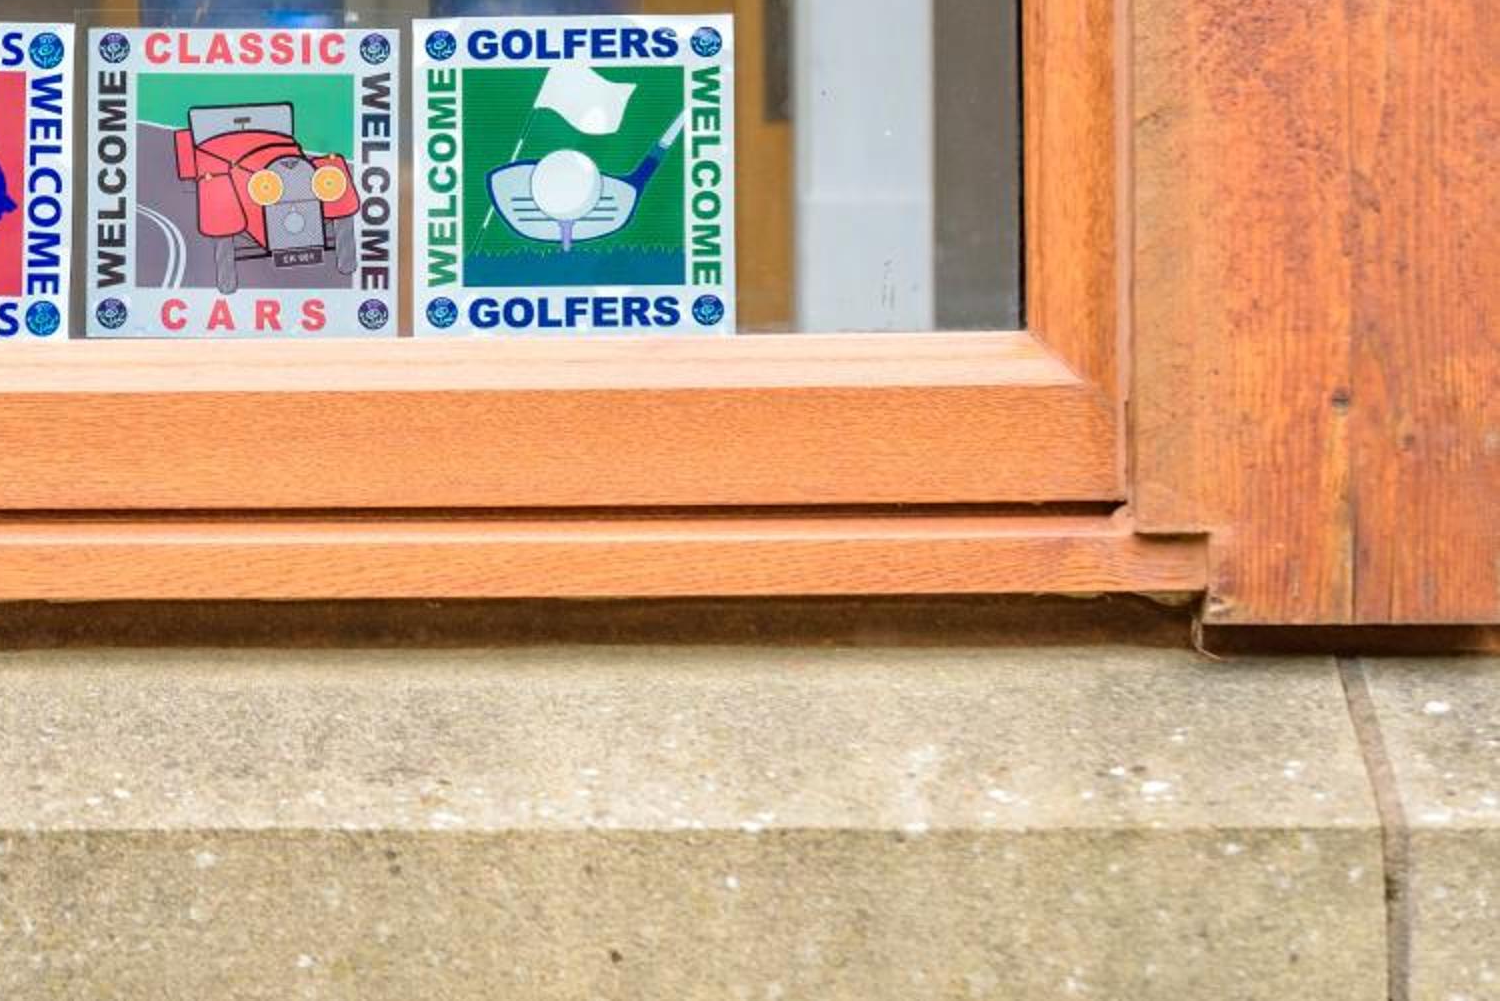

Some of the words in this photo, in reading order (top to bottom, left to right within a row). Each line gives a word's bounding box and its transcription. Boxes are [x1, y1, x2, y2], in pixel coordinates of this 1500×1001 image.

[144, 32, 346, 66] CLASSIC
[466, 27, 679, 61] GOLFERS
[27, 74, 64, 296] WELCOME
[97, 70, 127, 289] WELCOME
[360, 72, 391, 291] WELCOME
[427, 68, 457, 287] WELCOME
[690, 65, 721, 286] WELCOME
[160, 299, 327, 331] CARS
[468, 296, 681, 329] GOLFERS
